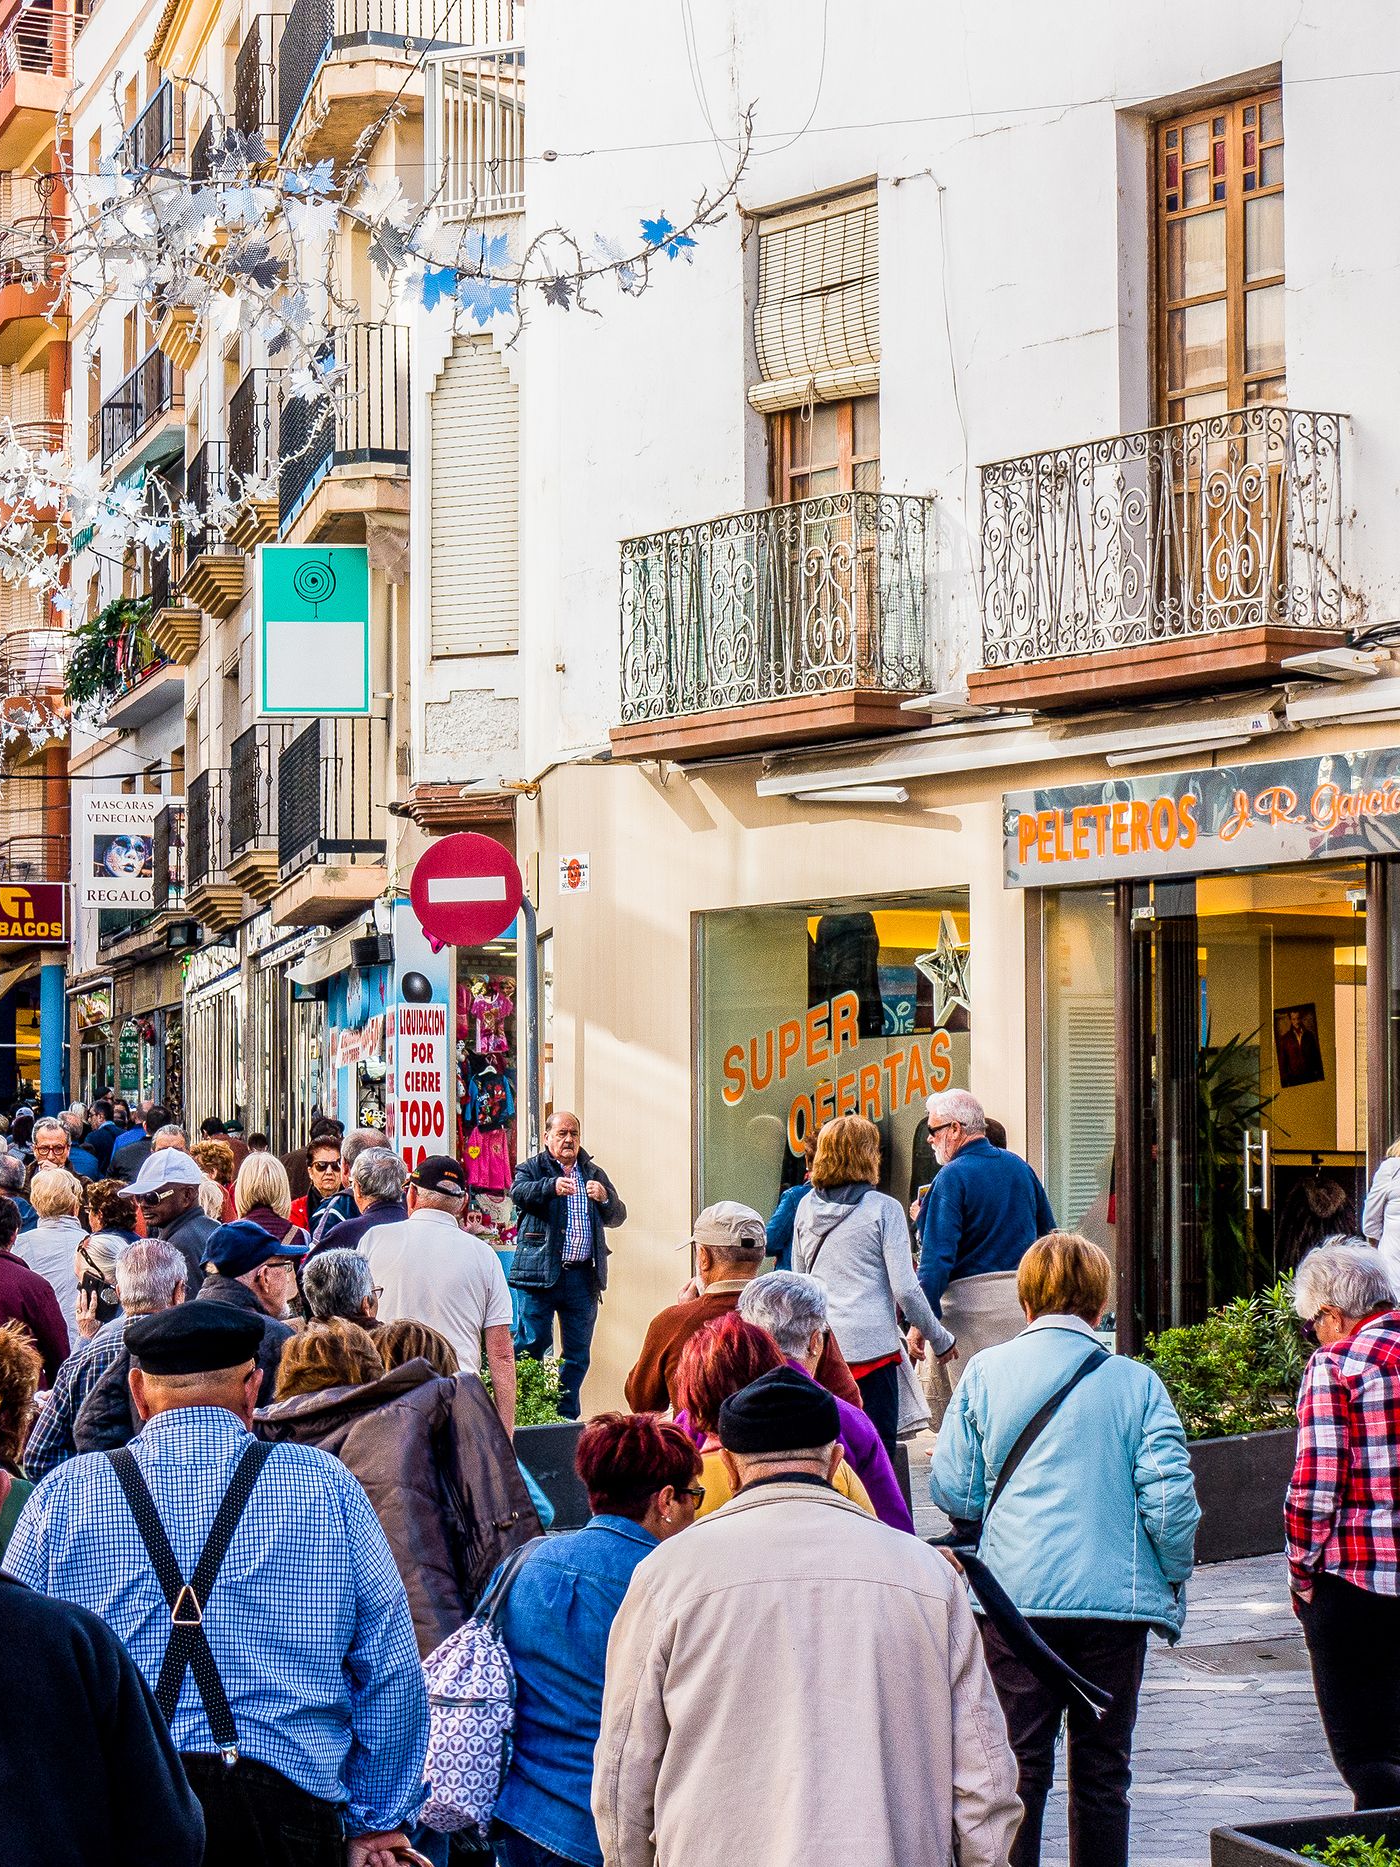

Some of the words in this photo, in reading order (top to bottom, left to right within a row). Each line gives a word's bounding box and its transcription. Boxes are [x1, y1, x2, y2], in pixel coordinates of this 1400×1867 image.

[90, 800, 155, 810] MASCARAS
[87, 814, 154, 823] VENECIANA
[1017, 793, 1199, 865] PELETEROS
[87, 889, 154, 902] REGALO
[399, 1005, 445, 1036] LIQUIDACIÓN
[411, 1042, 434, 1064] POR
[722, 990, 860, 1107] SUPER
[404, 1071, 441, 1093] CIERRE
[787, 1027, 953, 1158] OFERTAS
[400, 1099, 445, 1138] TODO
